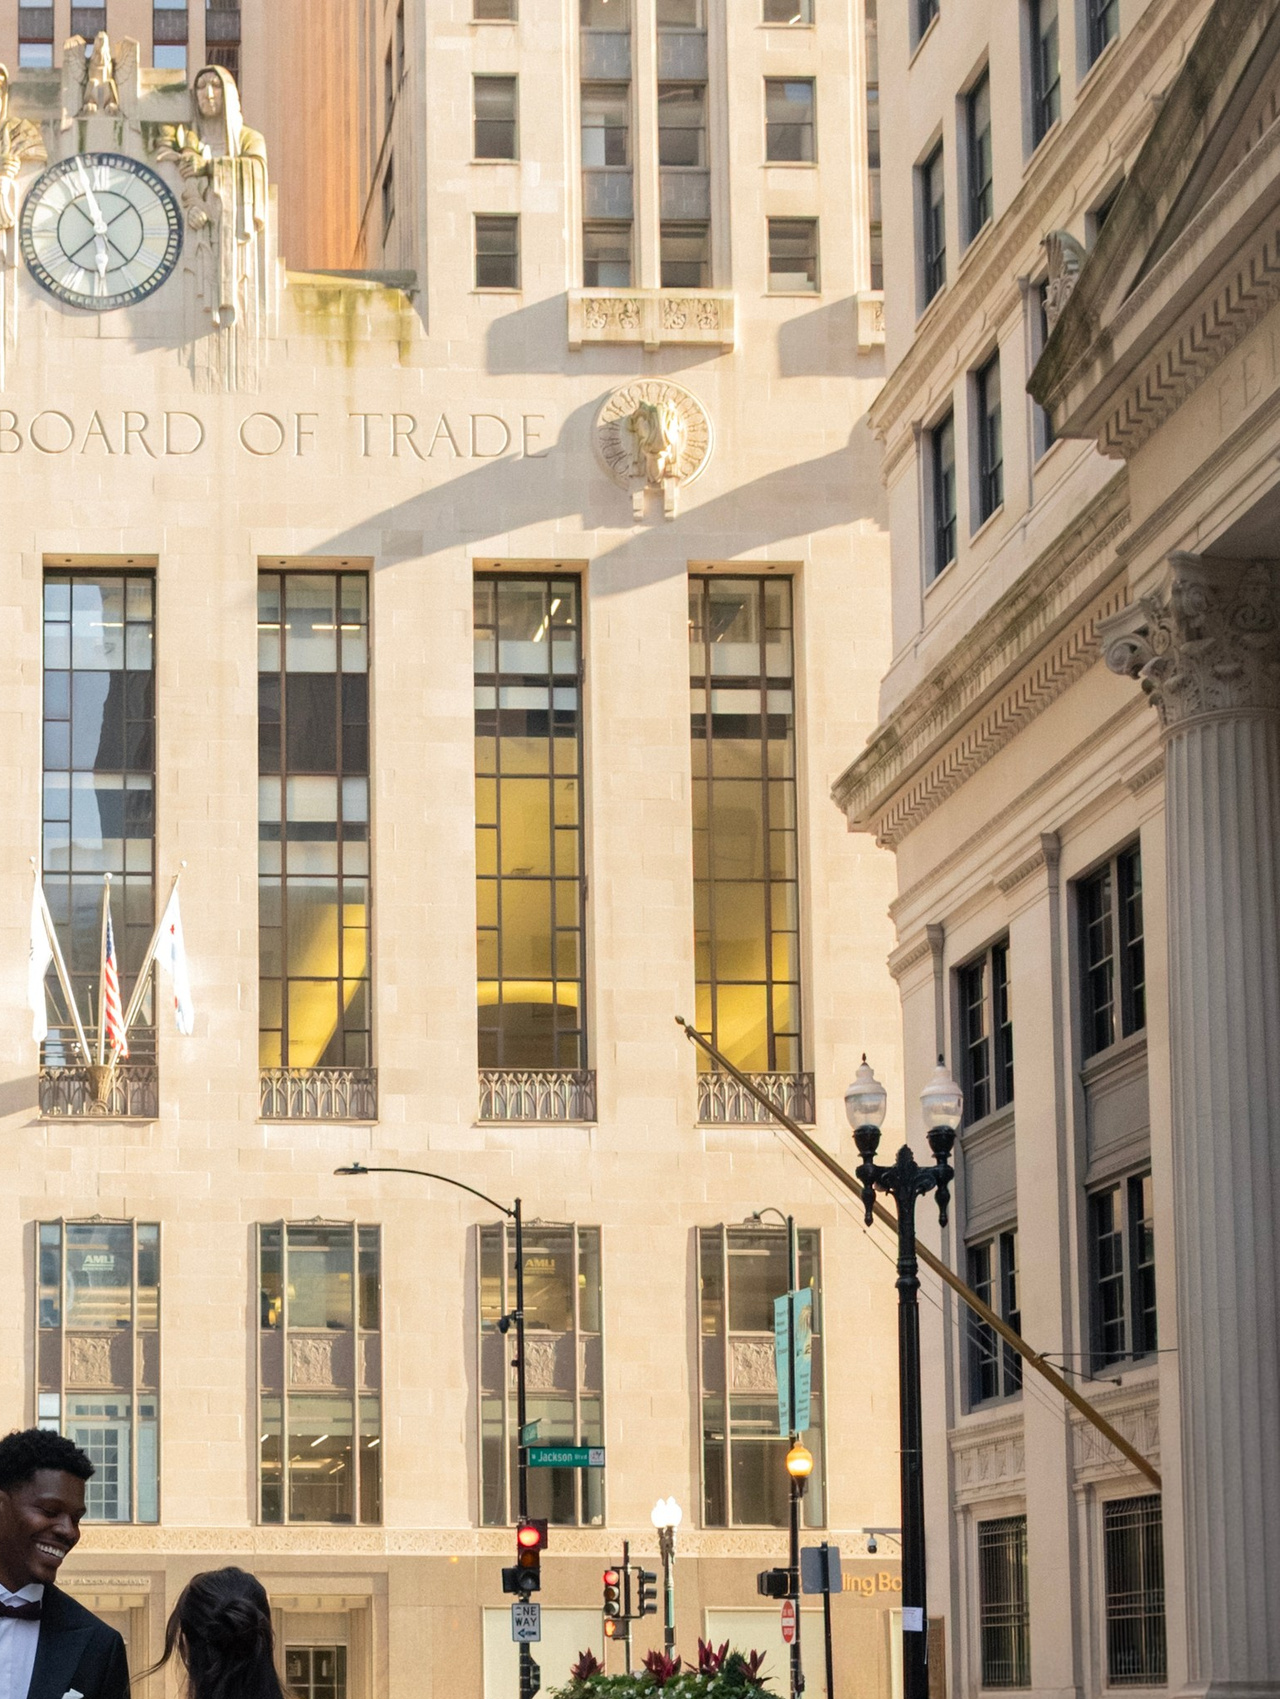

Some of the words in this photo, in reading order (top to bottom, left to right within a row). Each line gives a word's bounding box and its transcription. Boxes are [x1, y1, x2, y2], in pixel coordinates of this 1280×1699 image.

[238, 412, 319, 457] OF
[348, 413, 549, 461] TRADE
[84, 1255, 114, 1264] AMLI
[525, 1258, 555, 1267] AMLI
[538, 1451, 573, 1462] Jackson
[842, 1573, 876, 1597] ling
[878, 1572, 903, 1591] Bo
[515, 1606, 537, 1616] ONE
[515, 1617, 537, 1627] WAY
